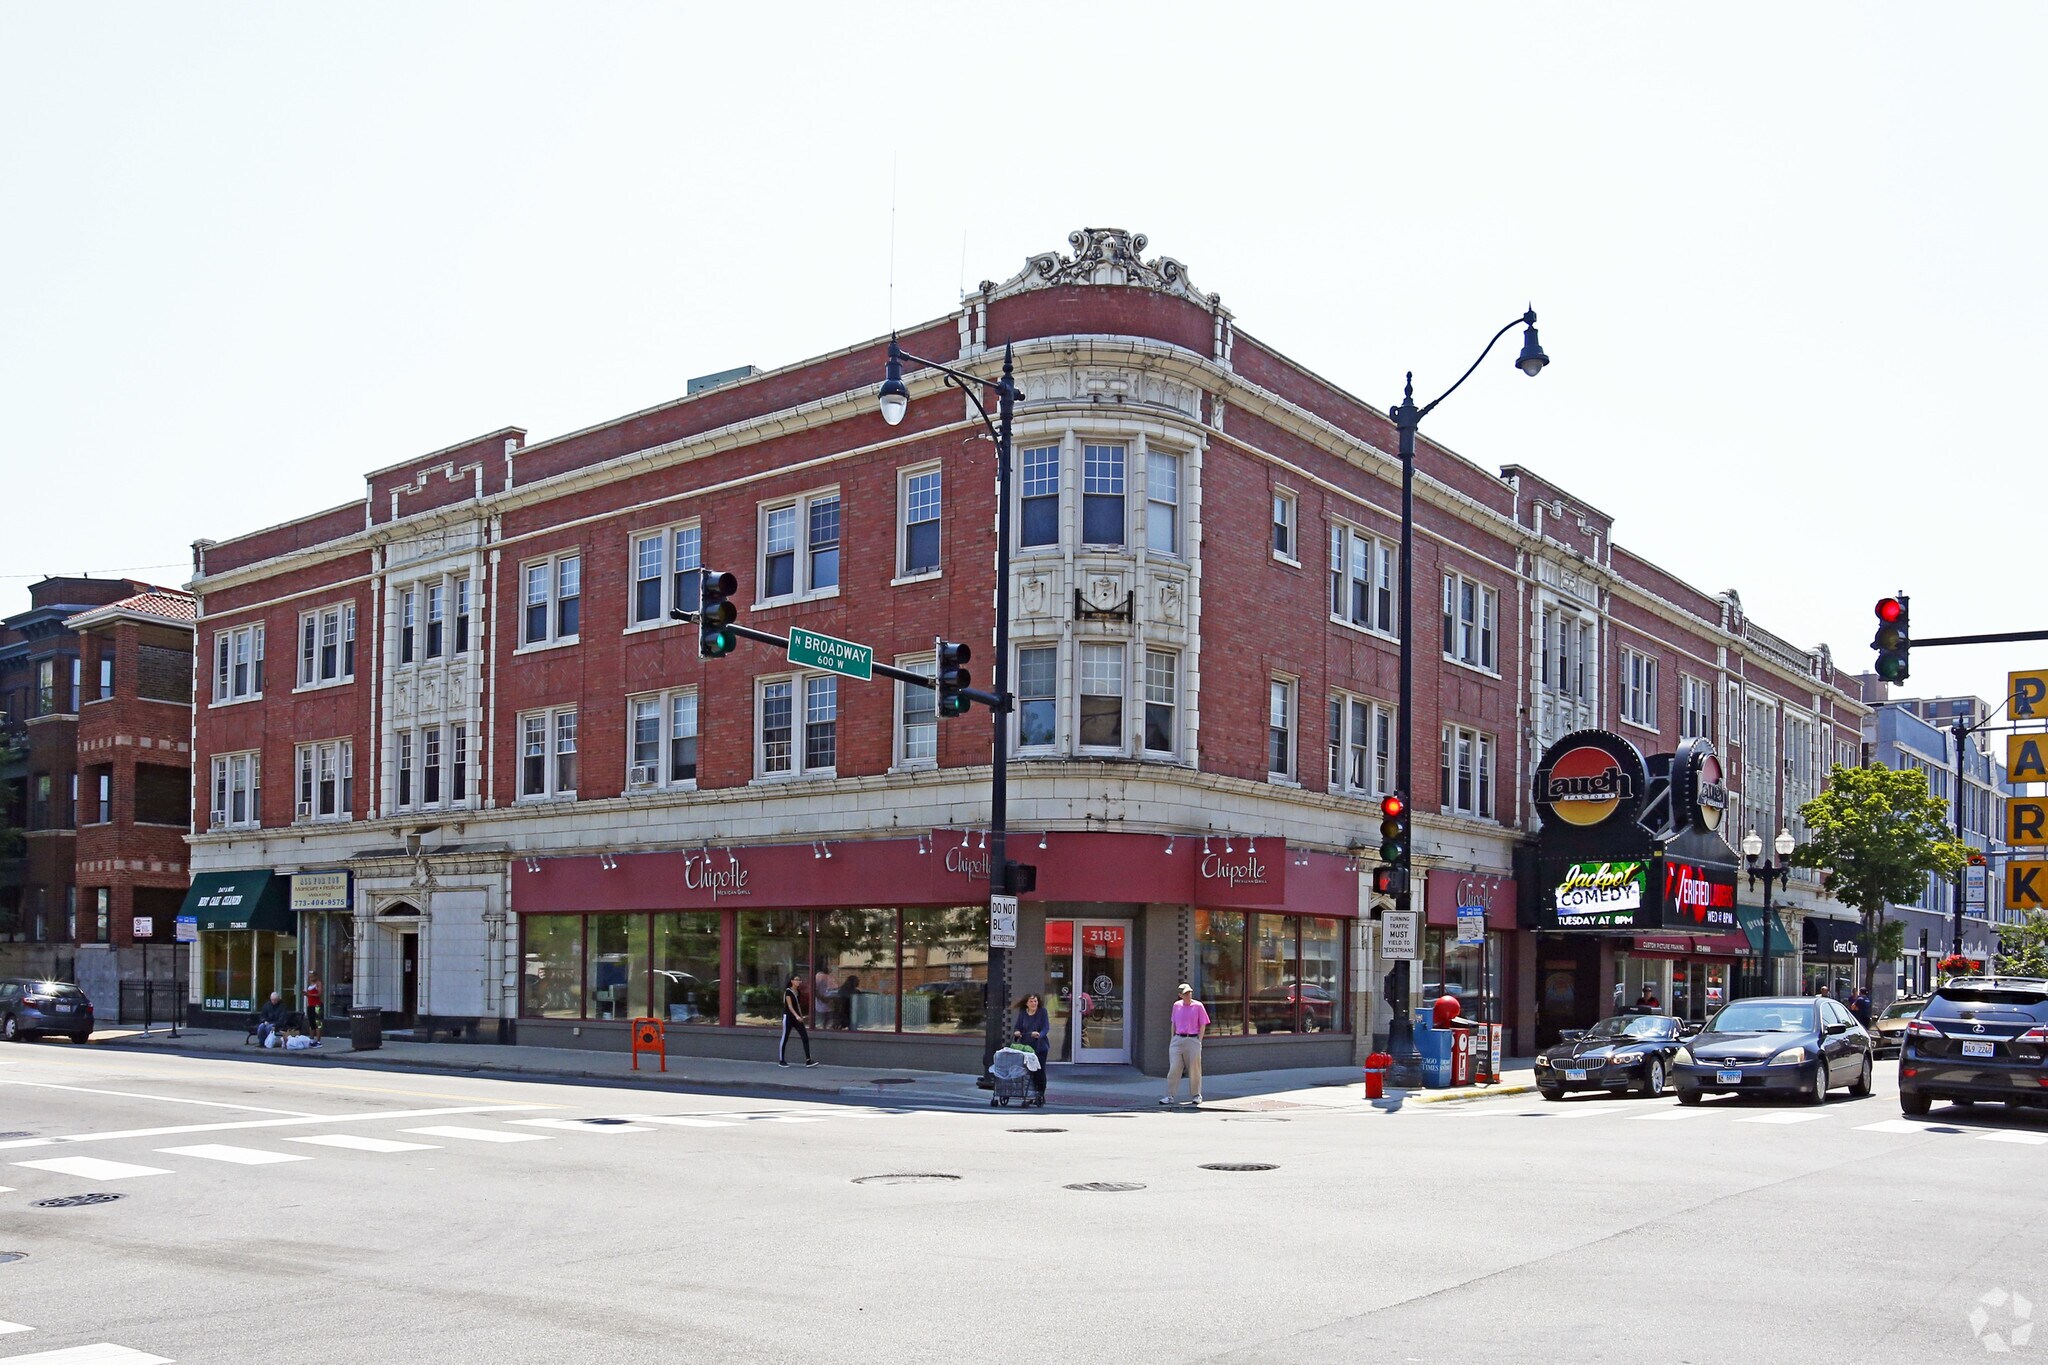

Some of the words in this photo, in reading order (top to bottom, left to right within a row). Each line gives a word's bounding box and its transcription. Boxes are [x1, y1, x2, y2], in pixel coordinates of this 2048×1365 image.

[795, 635, 802, 645] N
[804, 636, 867, 663] BROADWAY
[817, 655, 834, 667] 600
[837, 659, 844, 669] W
[1537, 767, 1634, 803] Laugh
[2013, 677, 2046, 902] PARK
[1566, 793, 1614, 801] FACTORY
[1201, 853, 1266, 888] Chipotle
[1560, 861, 1640, 892] Jackpot
[685, 855, 748, 902] Chipotle
[294, 898, 345, 907] 773-404-9575
[1561, 886, 1632, 906] COMEDY
[992, 903, 1002, 914] DO
[1003, 903, 1016, 914] NOT
[993, 918, 1015, 930] BLK
[1558, 916, 1596, 926] TUESDAY
[1598, 916, 1610, 925] AT
[1615, 915, 1633, 925] 8PM
[1707, 910, 1718, 923] WED
[1722, 912, 1733, 924] 8PM
[1090, 930, 1118, 941] 3181
[1642, 941, 1657, 949] CUSTOM
[1833, 939, 1847, 952] Great
[1847, 940, 1858, 956] Clips
